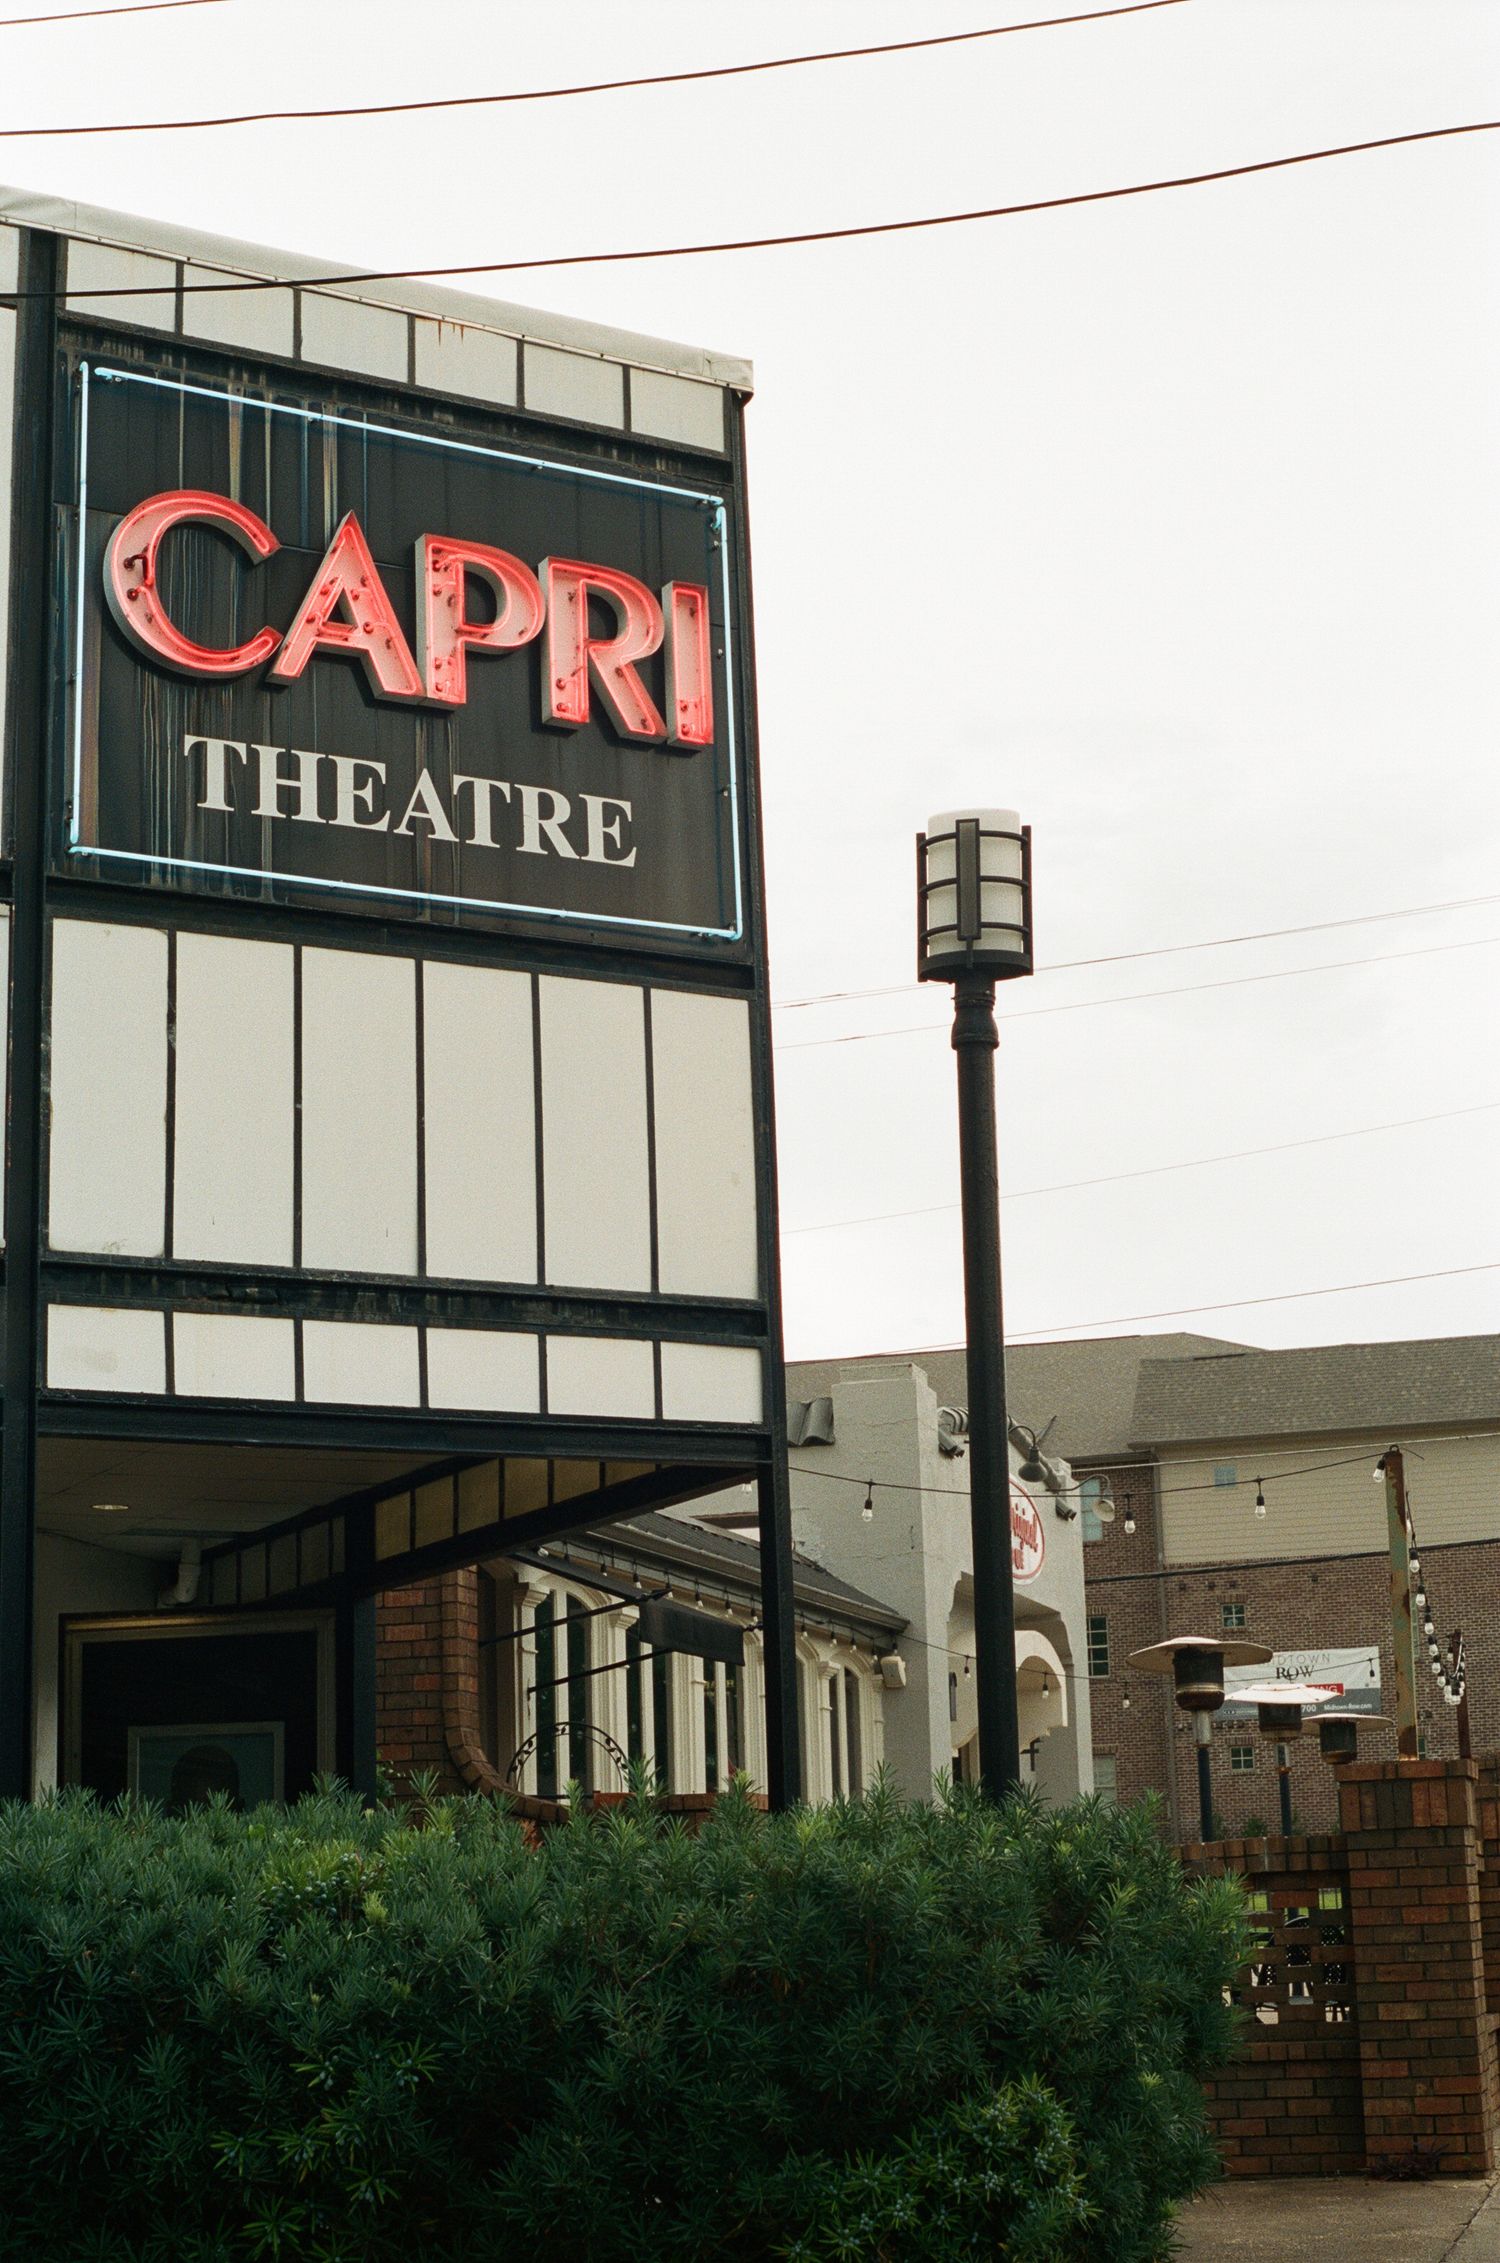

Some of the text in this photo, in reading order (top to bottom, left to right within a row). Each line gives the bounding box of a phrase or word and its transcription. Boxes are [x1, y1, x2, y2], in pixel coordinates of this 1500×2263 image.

[103, 490, 714, 750] CAPRI
[183, 734, 638, 868] THEATRE
[1271, 1652, 1331, 1666] IDTOWN
[1275, 1664, 1315, 1681] ROW
